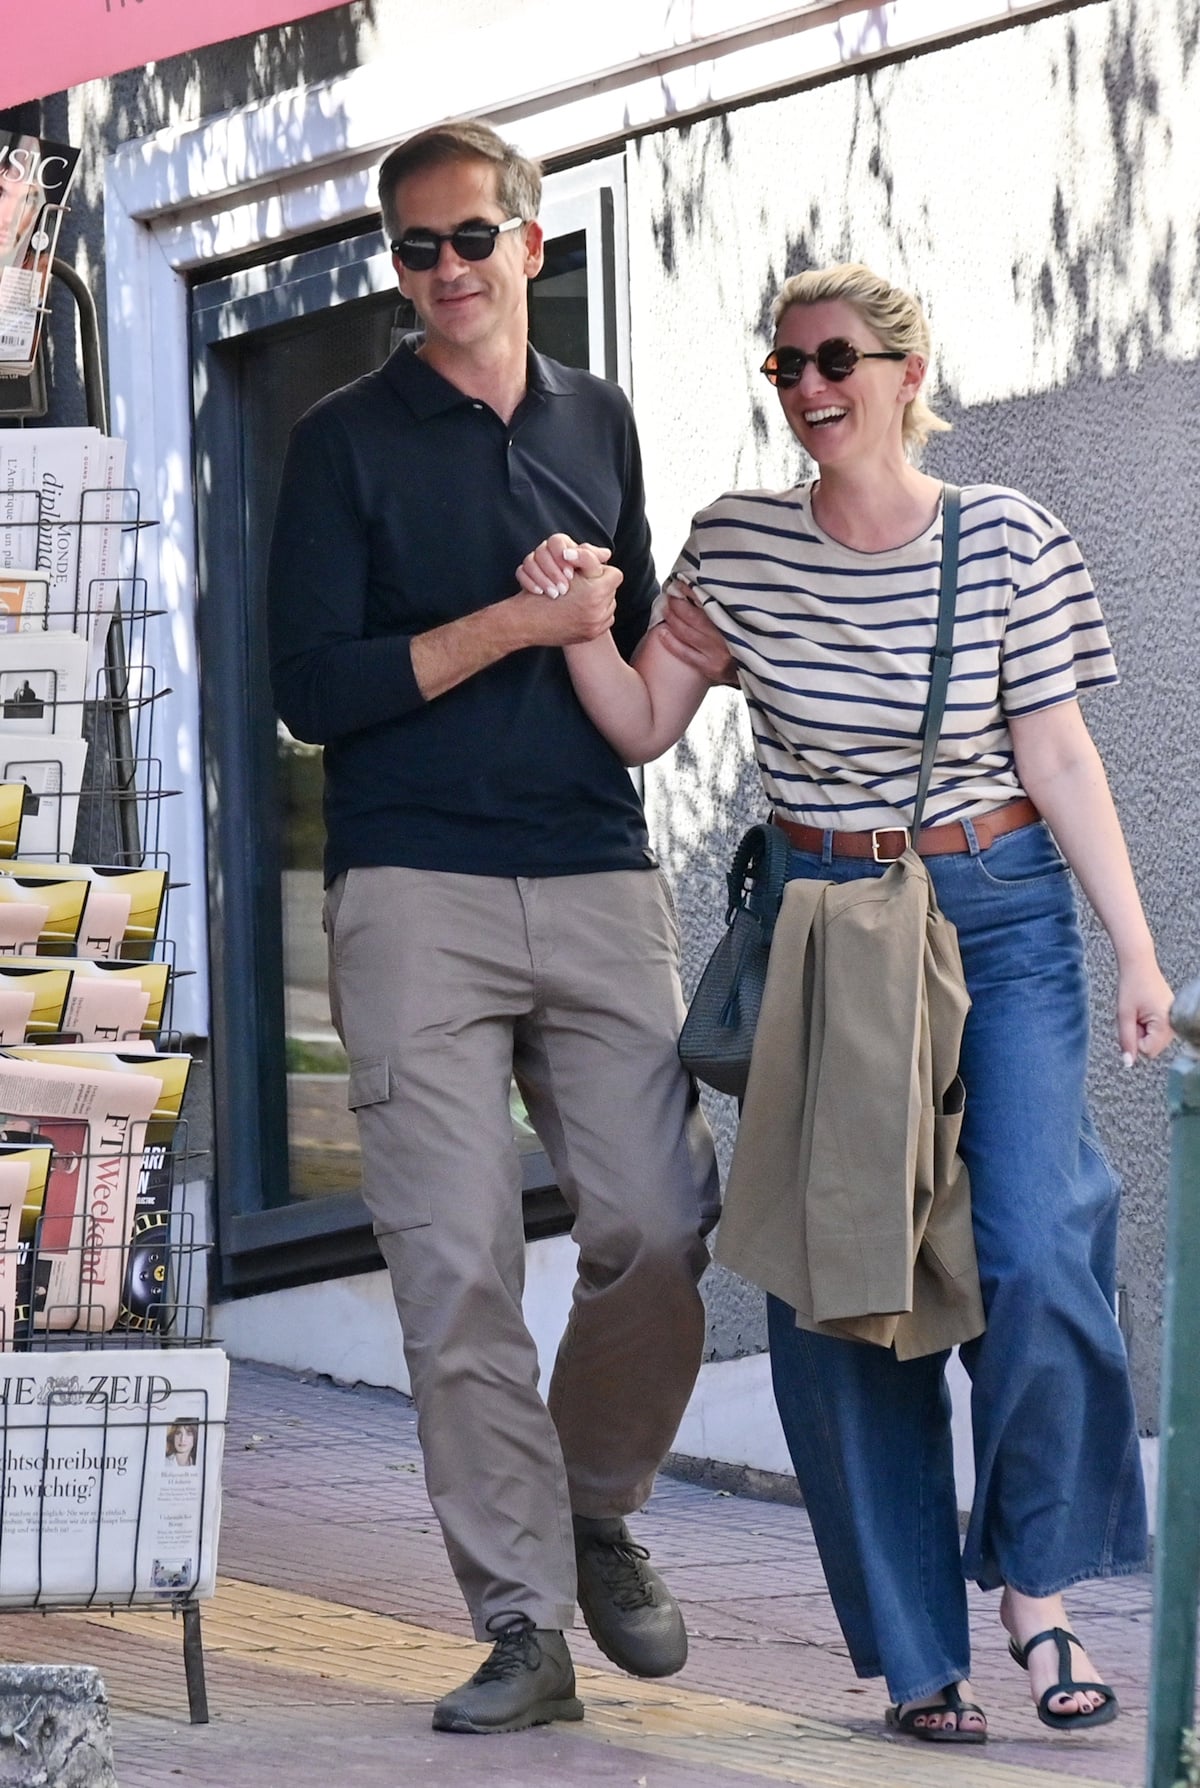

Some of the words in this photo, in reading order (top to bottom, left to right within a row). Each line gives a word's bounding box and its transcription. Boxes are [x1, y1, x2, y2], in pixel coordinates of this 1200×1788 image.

[86, 1375, 172, 1404] ZEID
[0, 1448, 128, 1476] htschreibung
[23, 1476, 96, 1504] wichtig?
